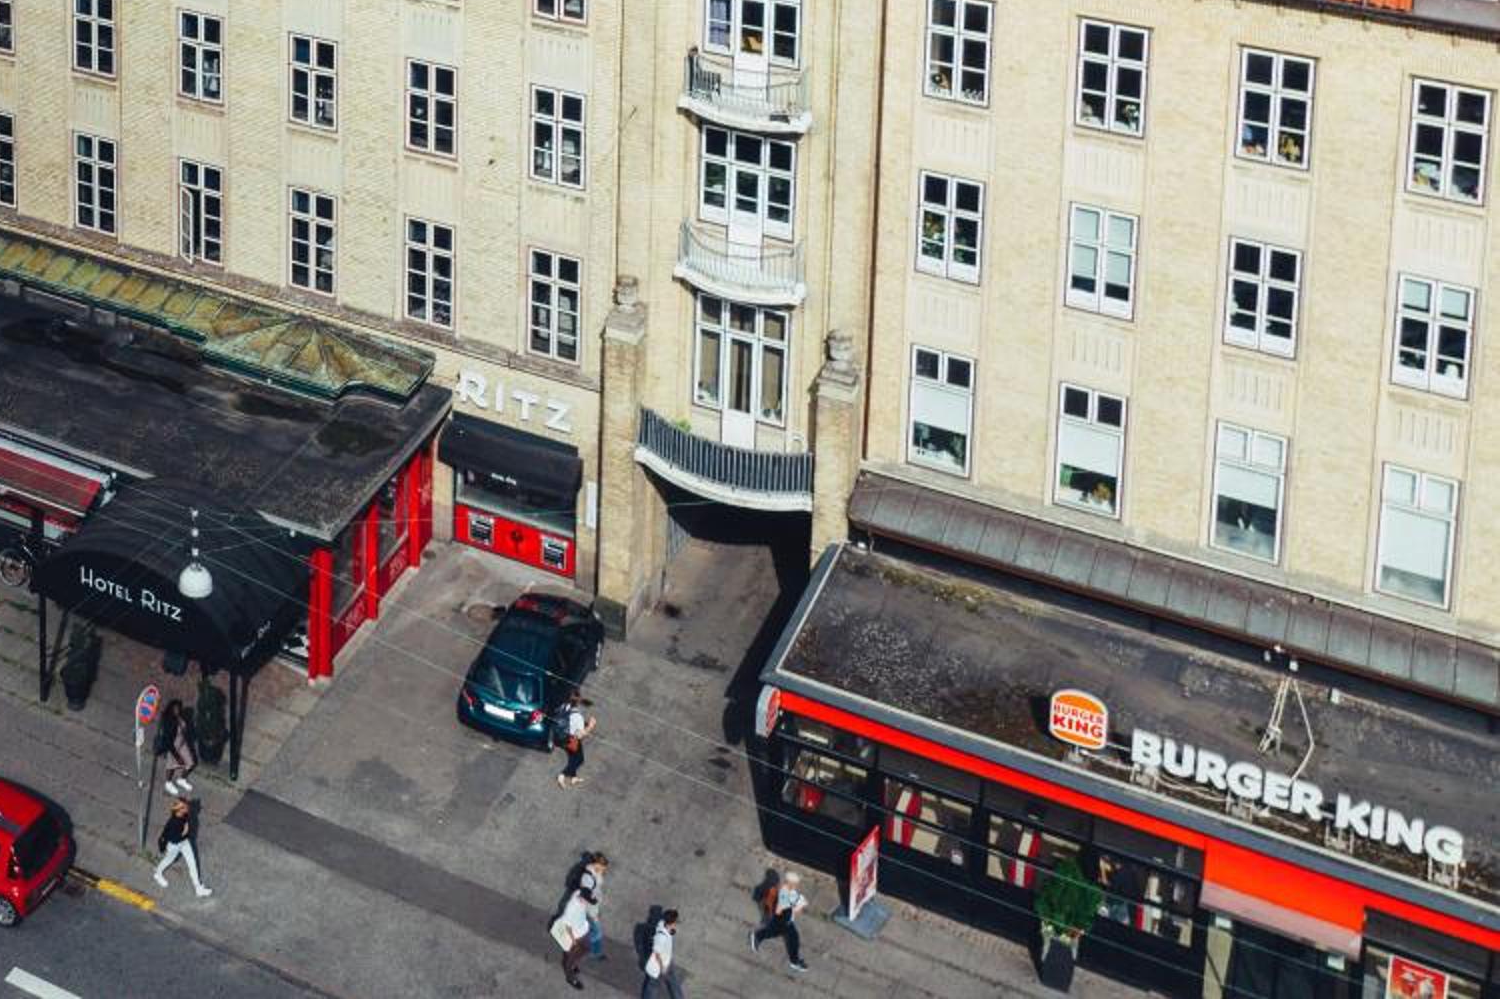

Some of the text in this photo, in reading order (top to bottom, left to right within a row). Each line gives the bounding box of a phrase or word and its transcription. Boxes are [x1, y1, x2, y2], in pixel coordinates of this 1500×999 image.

[456, 369, 572, 433] RITZ
[79, 565, 182, 622] HOTEL RITZ
[1052, 714, 1104, 738] KING
[1053, 703, 1104, 724] BURGER
[1131, 728, 1465, 865] BURGER KING
